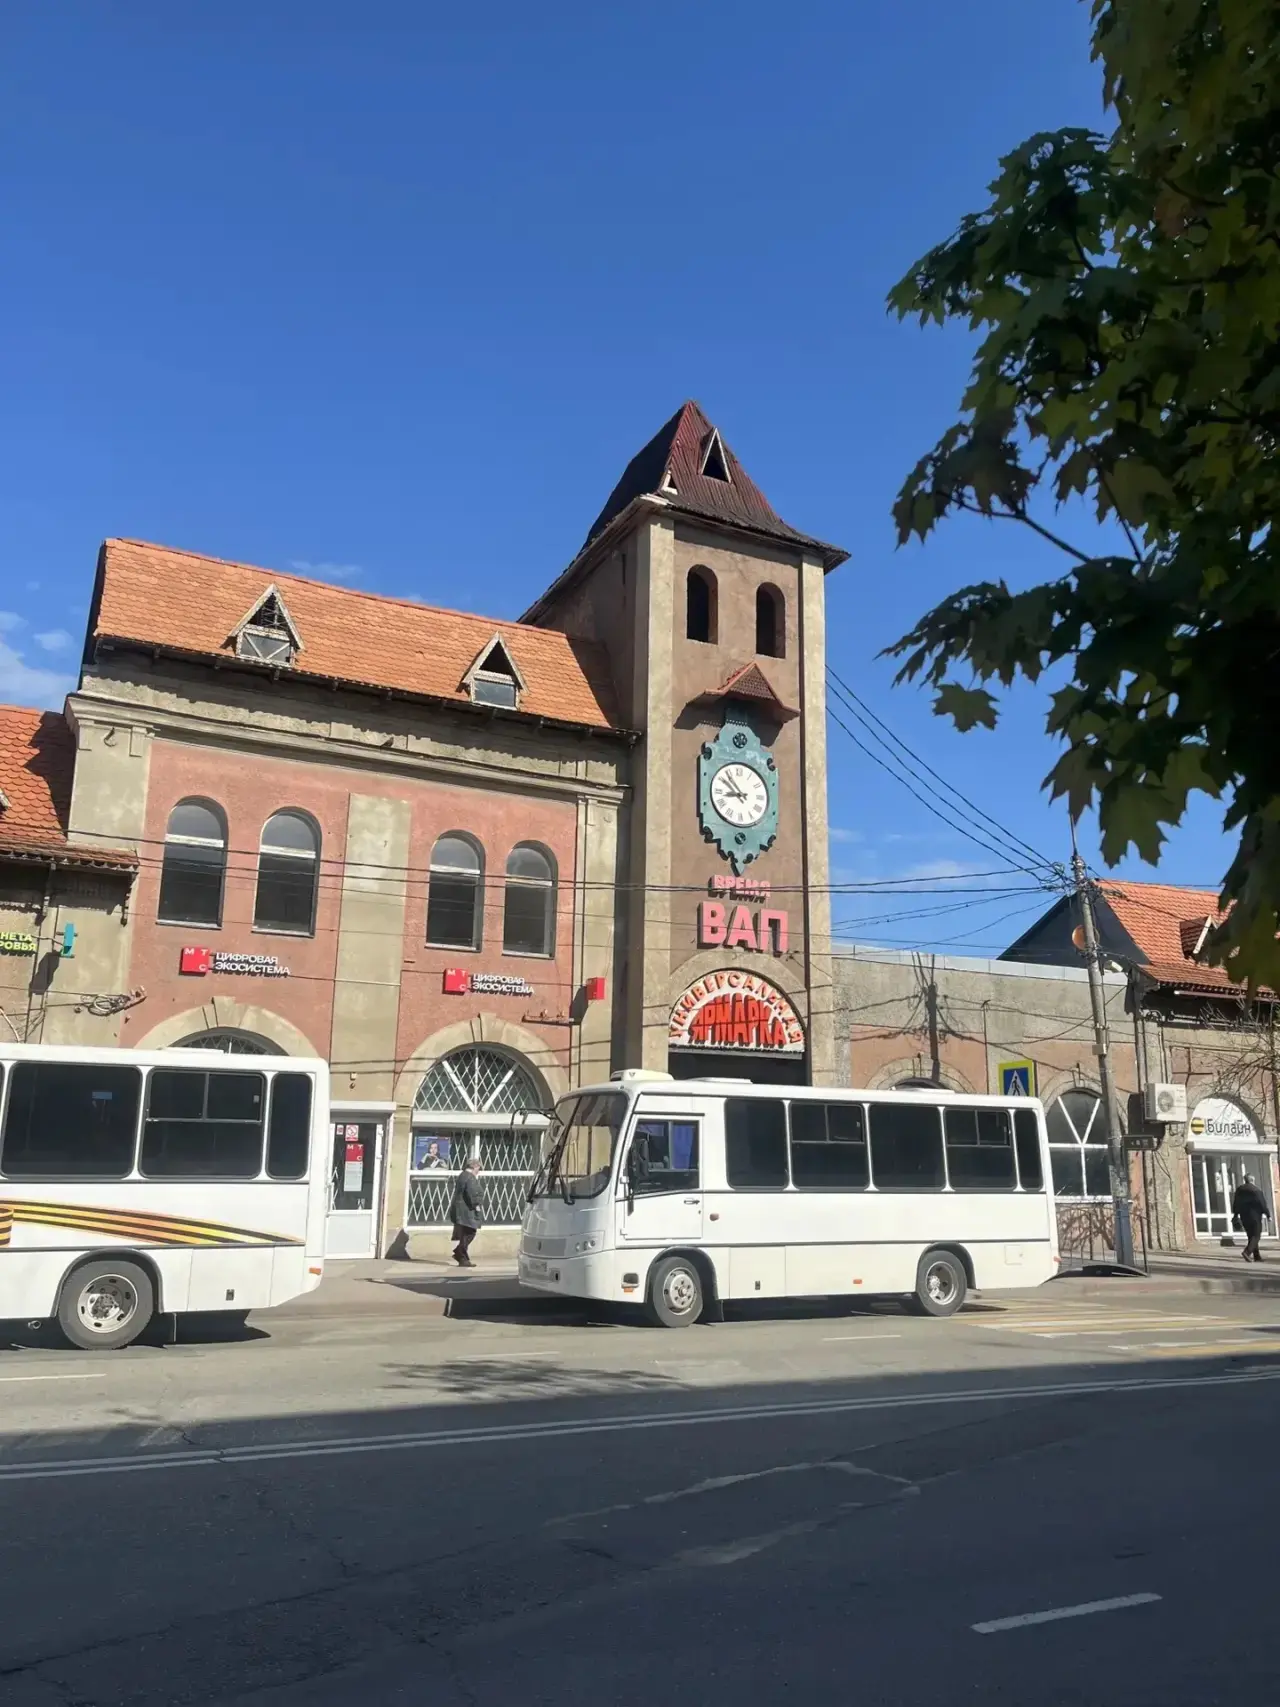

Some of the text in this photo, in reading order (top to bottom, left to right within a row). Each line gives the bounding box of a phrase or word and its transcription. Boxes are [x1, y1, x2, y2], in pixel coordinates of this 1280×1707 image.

[701, 900, 789, 954] ВАП
[215, 952, 278, 965] ЦИФРОВАЯ
[215, 961, 290, 975] ЭКОСИСТЕМА
[472, 973, 525, 985] ЦИФРОВАЯ
[472, 982, 534, 994] ЭКОСИСТЕМА
[689, 992, 787, 1047] ЯРМАРКА
